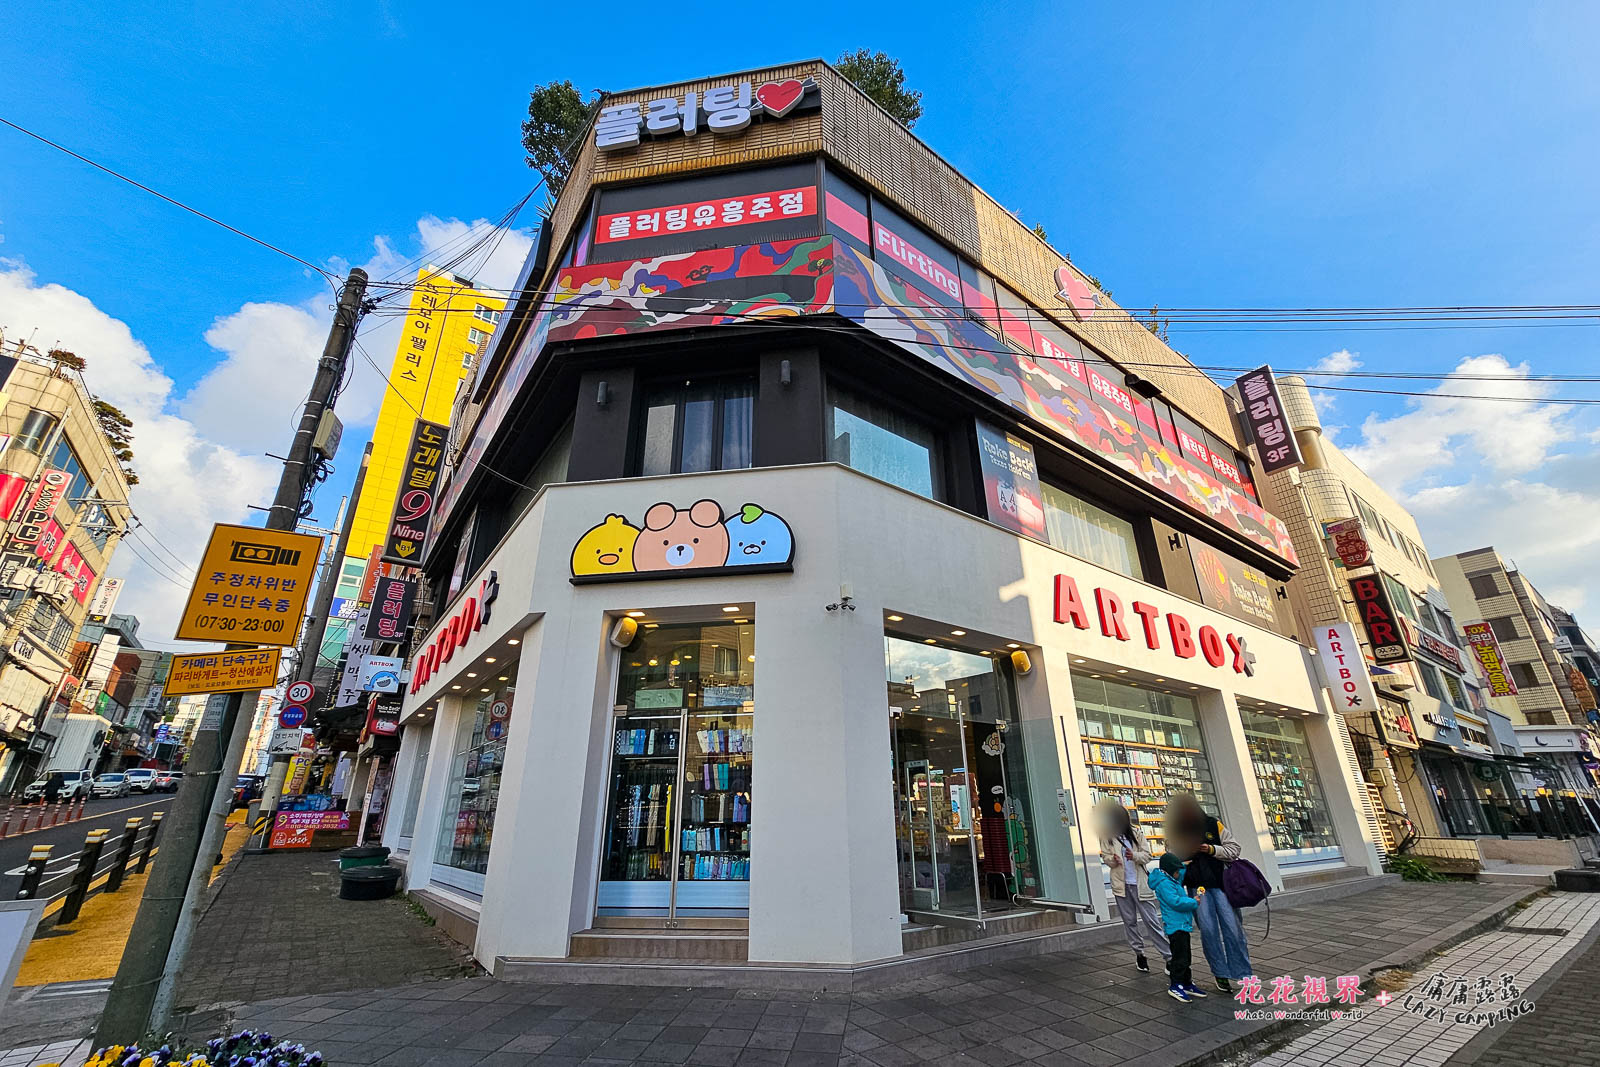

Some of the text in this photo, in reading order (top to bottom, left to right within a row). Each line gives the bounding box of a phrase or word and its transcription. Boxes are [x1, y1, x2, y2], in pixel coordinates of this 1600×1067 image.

[594, 81, 753, 151] 플러팅
[608, 191, 804, 240] 플러팅유흥주점
[877, 227, 960, 298] Flirting
[1244, 374, 1286, 446] 플러팅
[408, 425, 443, 489] 노래텔
[1266, 445, 1290, 463] 3F
[15, 510, 48, 541] PC
[396, 490, 433, 522] 9
[392, 524, 425, 541] Nine
[209, 571, 297, 592] 주정차위반
[202, 592, 290, 613] 무인단속중
[378, 581, 405, 638] 플러팅
[1355, 579, 1397, 645] BAR
[194, 615, 284, 633] (07:30~23:00)
[410, 570, 500, 695] ARTBOX
[1053, 573, 1256, 677] ARTBOX
[173, 669, 220, 682] 파리바게트
[181, 653, 270, 669] 카메라 단속구간
[1328, 627, 1362, 707] ARTBOX
[292, 687, 308, 699] 30
